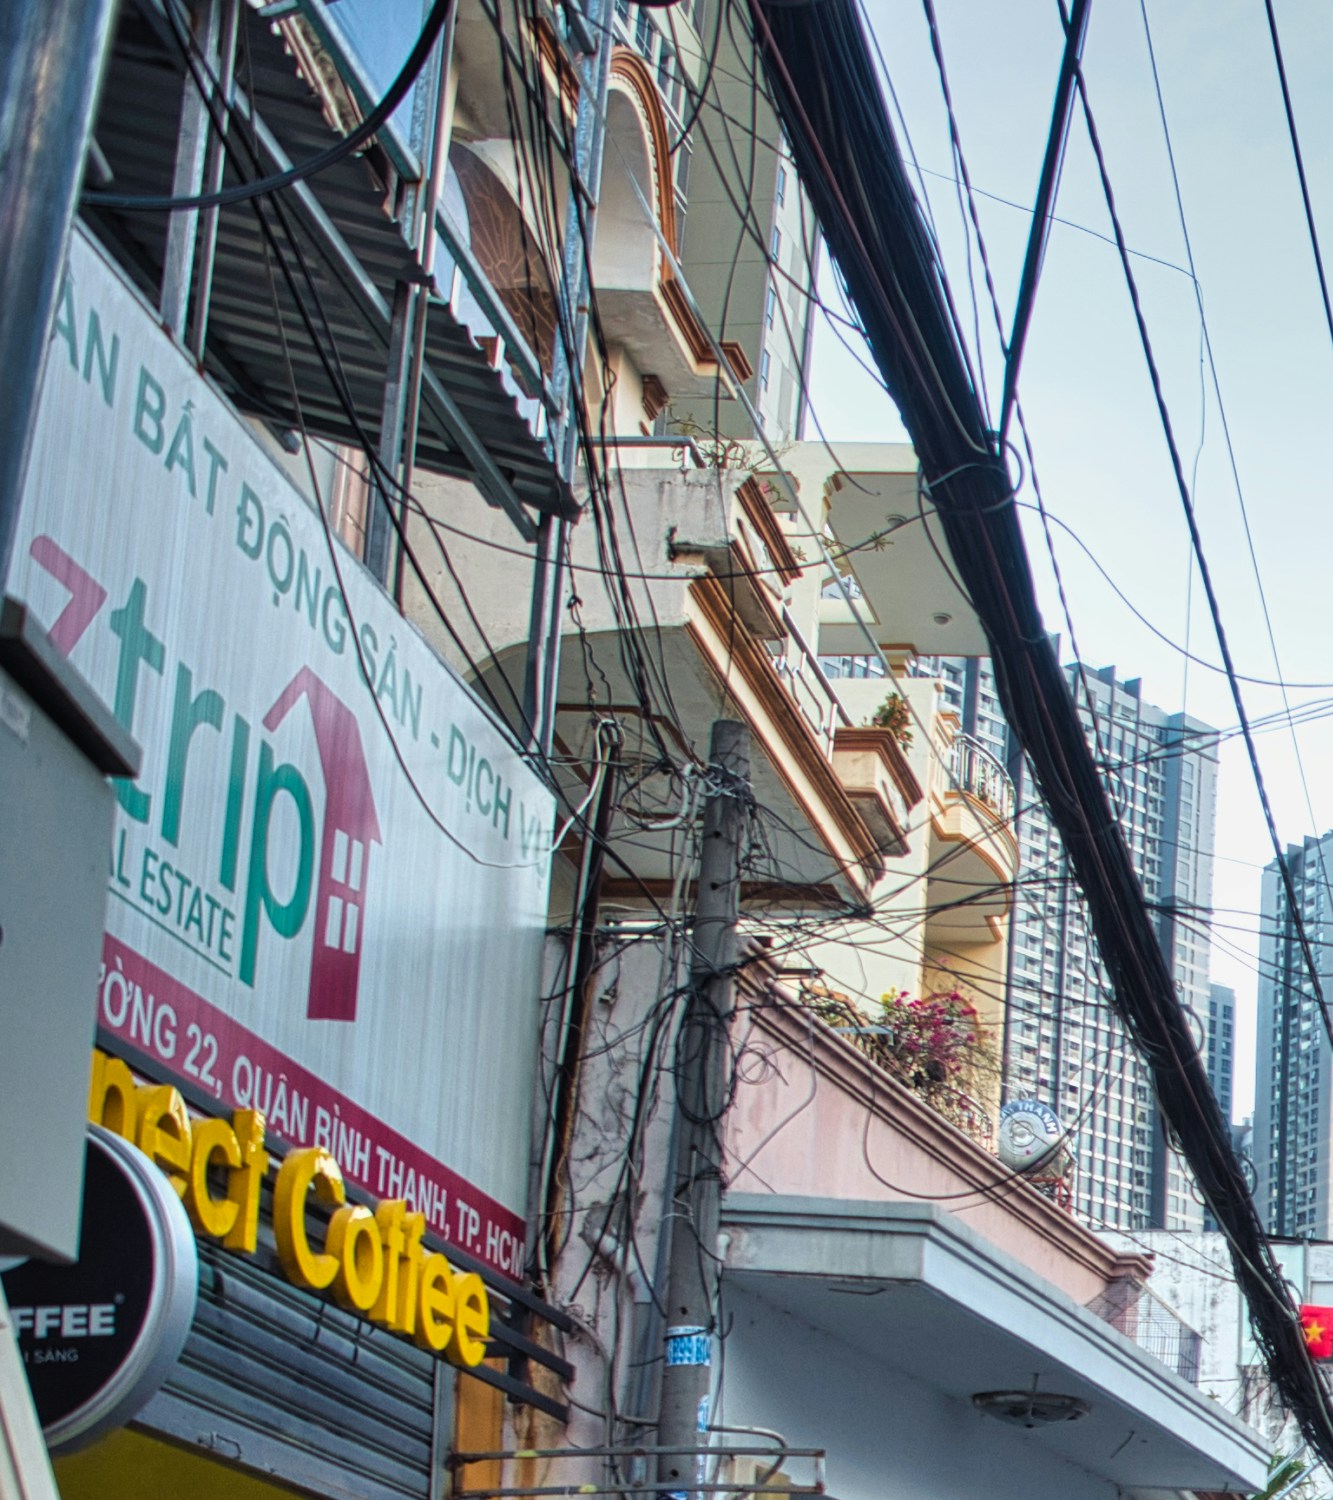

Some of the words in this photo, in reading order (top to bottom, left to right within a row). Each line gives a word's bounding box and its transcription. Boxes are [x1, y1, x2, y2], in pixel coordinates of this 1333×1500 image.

[133, 398, 228, 517] BẤT
[236, 482, 349, 655] ĐỘNG
[357, 620, 423, 742] SẢN
[447, 752, 512, 841] DỊCH
[140, 848, 236, 964] ESTATE
[182, 1022, 223, 1099] 22,
[232, 1056, 308, 1148] QUẬN
[313, 1100, 371, 1184] BÌNH
[456, 1196, 482, 1254] TP.
[486, 1222, 524, 1280] HCM
[273, 1146, 490, 1368] Coffee
[10, 1303, 116, 1338] FFEE
